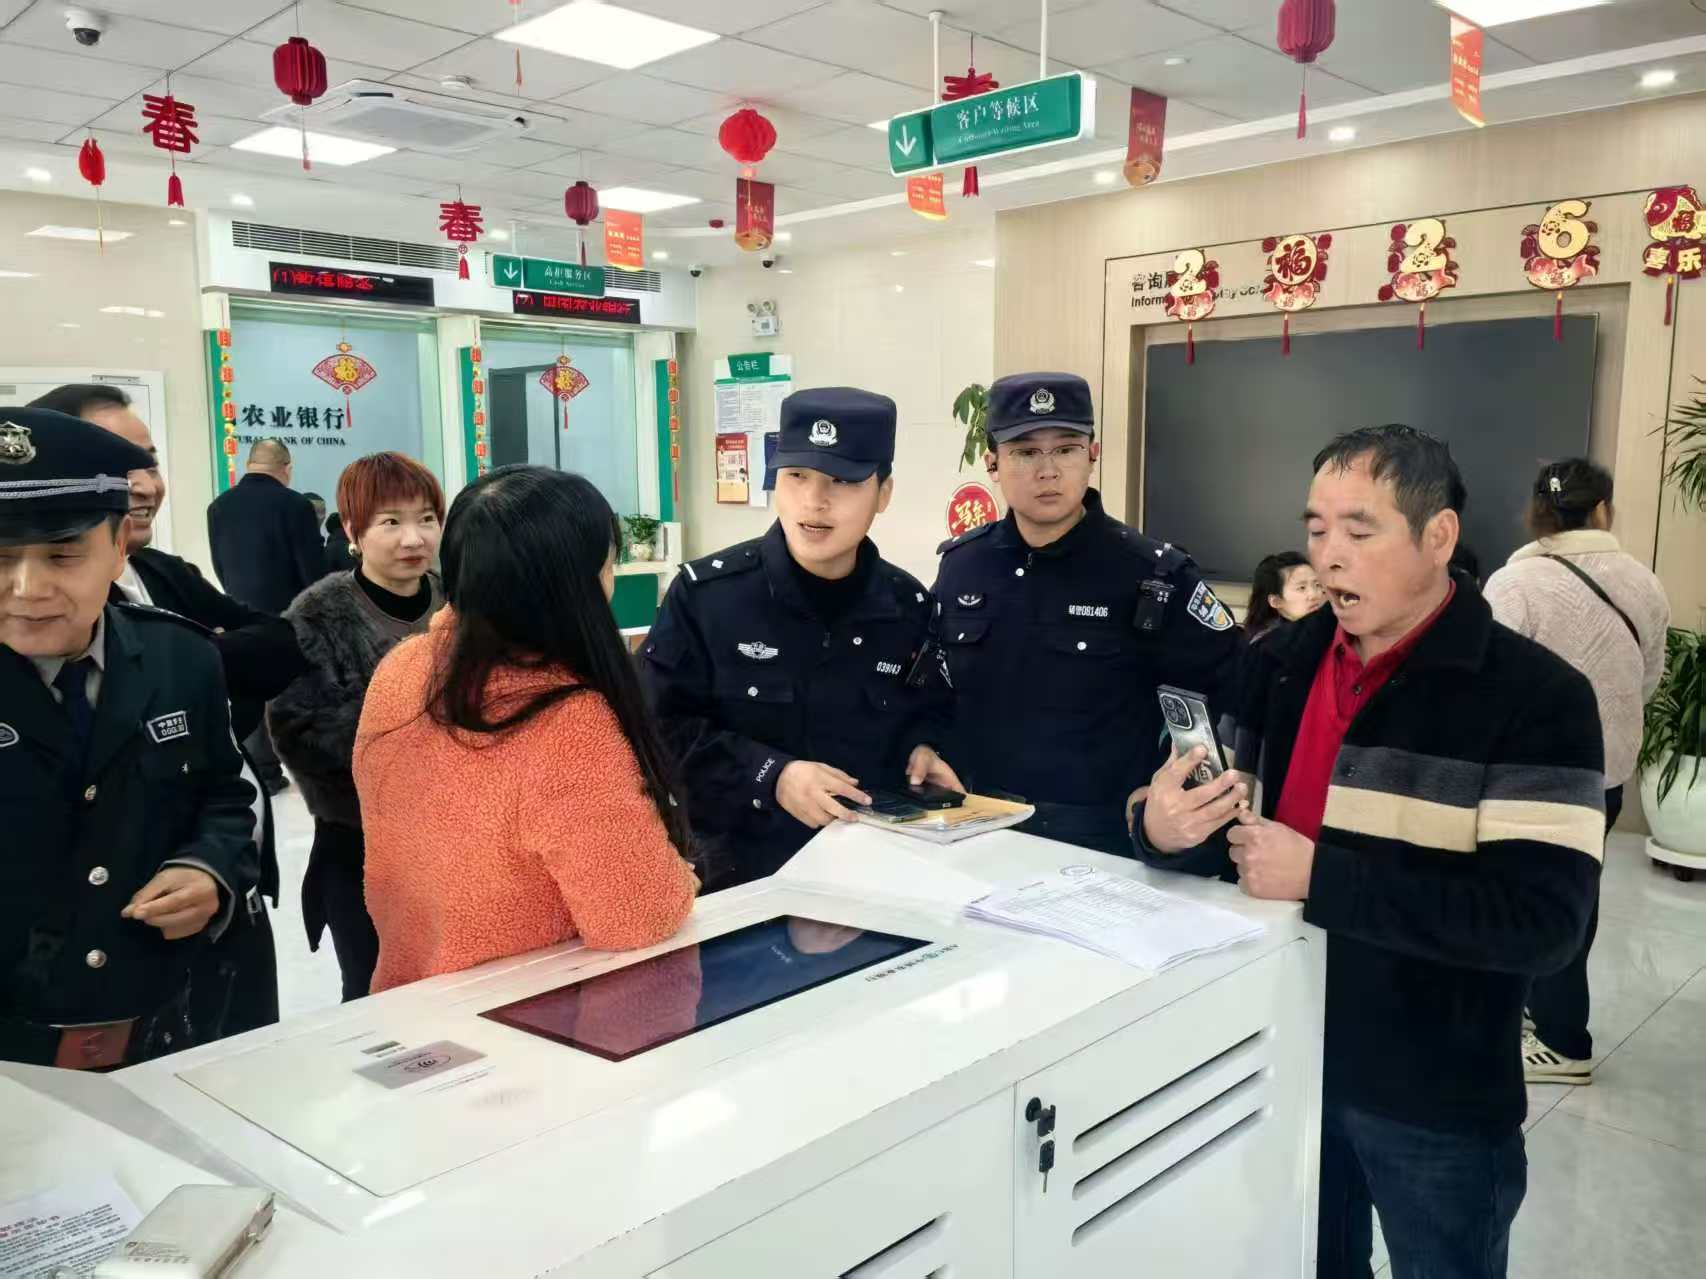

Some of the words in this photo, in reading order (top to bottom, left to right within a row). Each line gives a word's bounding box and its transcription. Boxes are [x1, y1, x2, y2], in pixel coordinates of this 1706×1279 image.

[142, 94, 199, 153] 春
[957, 92, 1040, 129] 客户等候区
[439, 200, 483, 241] 春
[1538, 200, 1590, 259] 6
[1132, 271, 1168, 292] 咨询
[233, 405, 345, 430] 农业银行
[301, 437, 314, 445] OF
[317, 437, 346, 447] CHINA
[755, 758, 776, 783] POLICE
